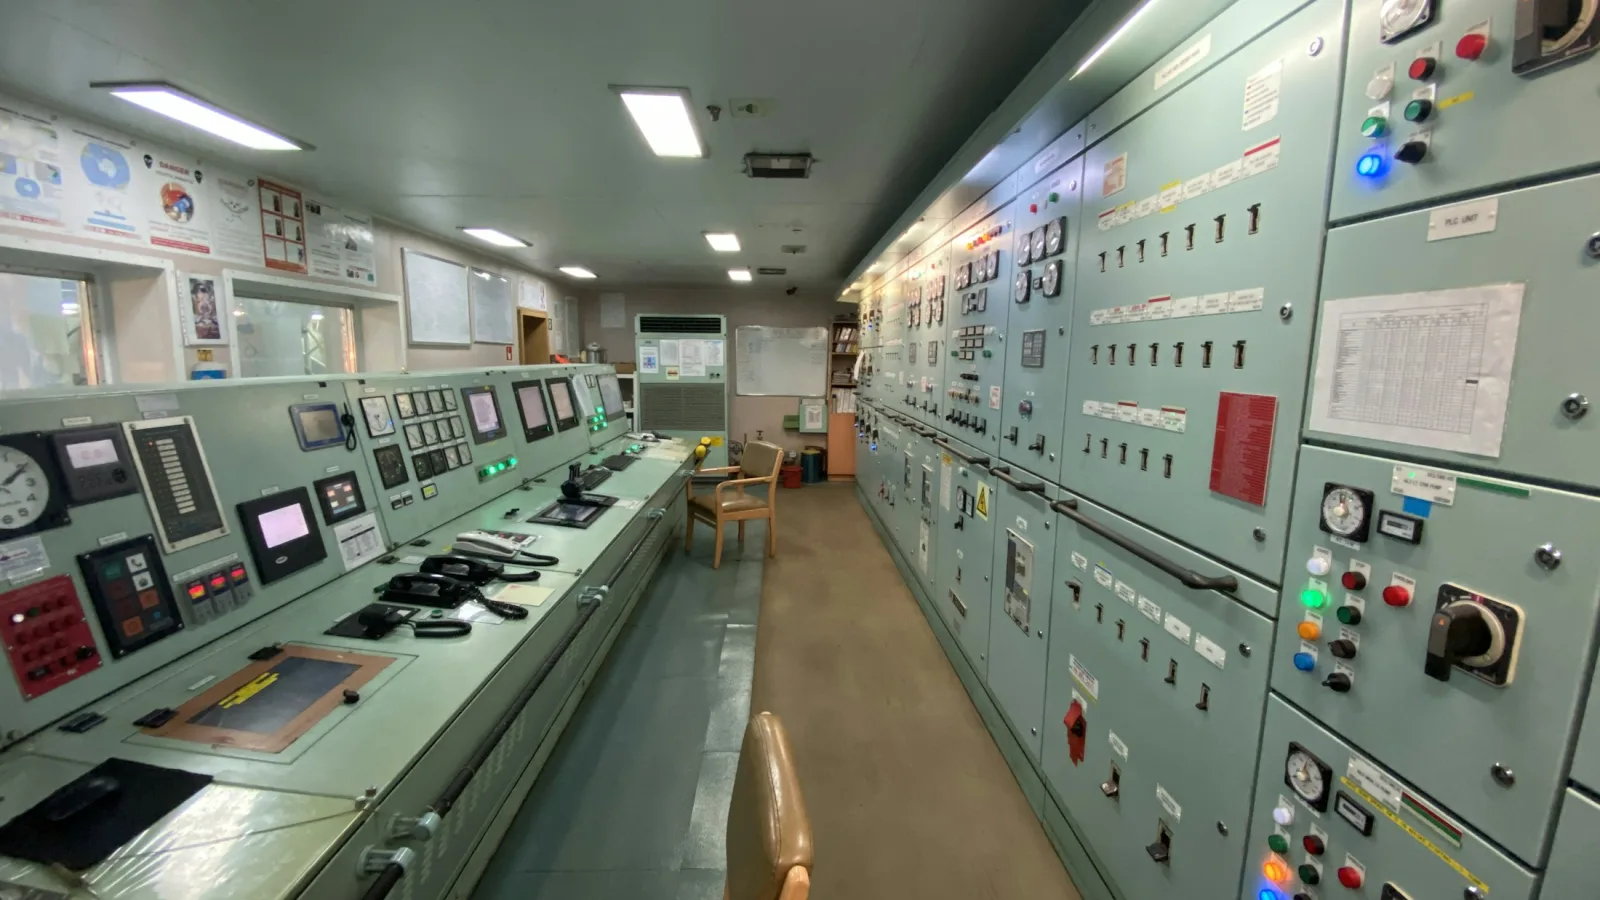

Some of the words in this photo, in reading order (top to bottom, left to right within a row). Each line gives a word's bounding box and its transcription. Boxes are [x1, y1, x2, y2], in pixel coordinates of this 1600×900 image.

[1445, 217, 1459, 227] PLC
[1461, 213, 1479, 224] UNIT
[26, 477, 36, 487] 3
[27, 493, 37, 502] 4
